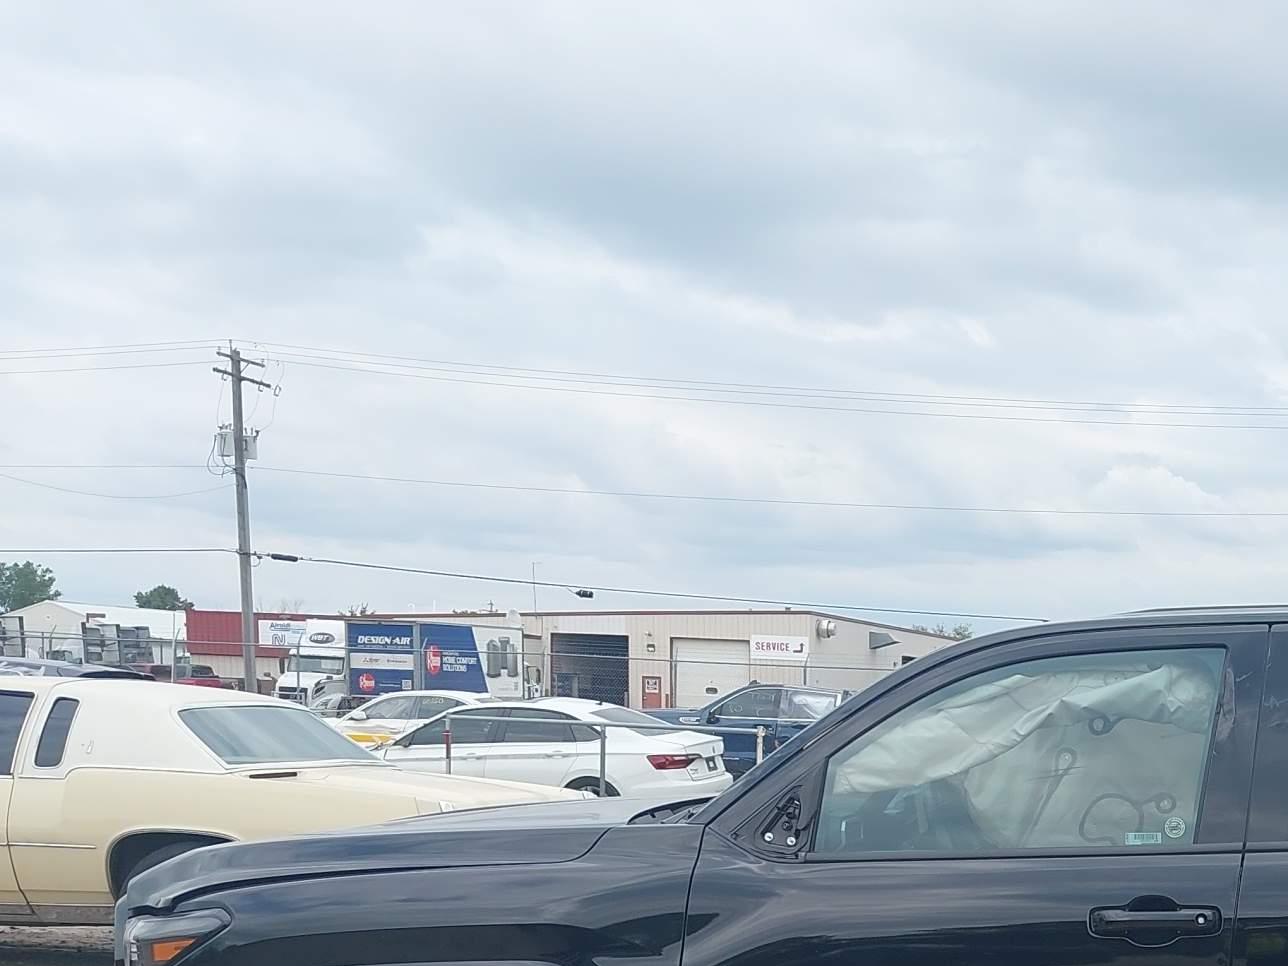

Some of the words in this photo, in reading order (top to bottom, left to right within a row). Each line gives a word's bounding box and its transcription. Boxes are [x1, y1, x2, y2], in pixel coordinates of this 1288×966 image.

[357, 635, 392, 645] DESIGN
[392, 636, 411, 645] AIR
[755, 641, 790, 652] SERVICE
